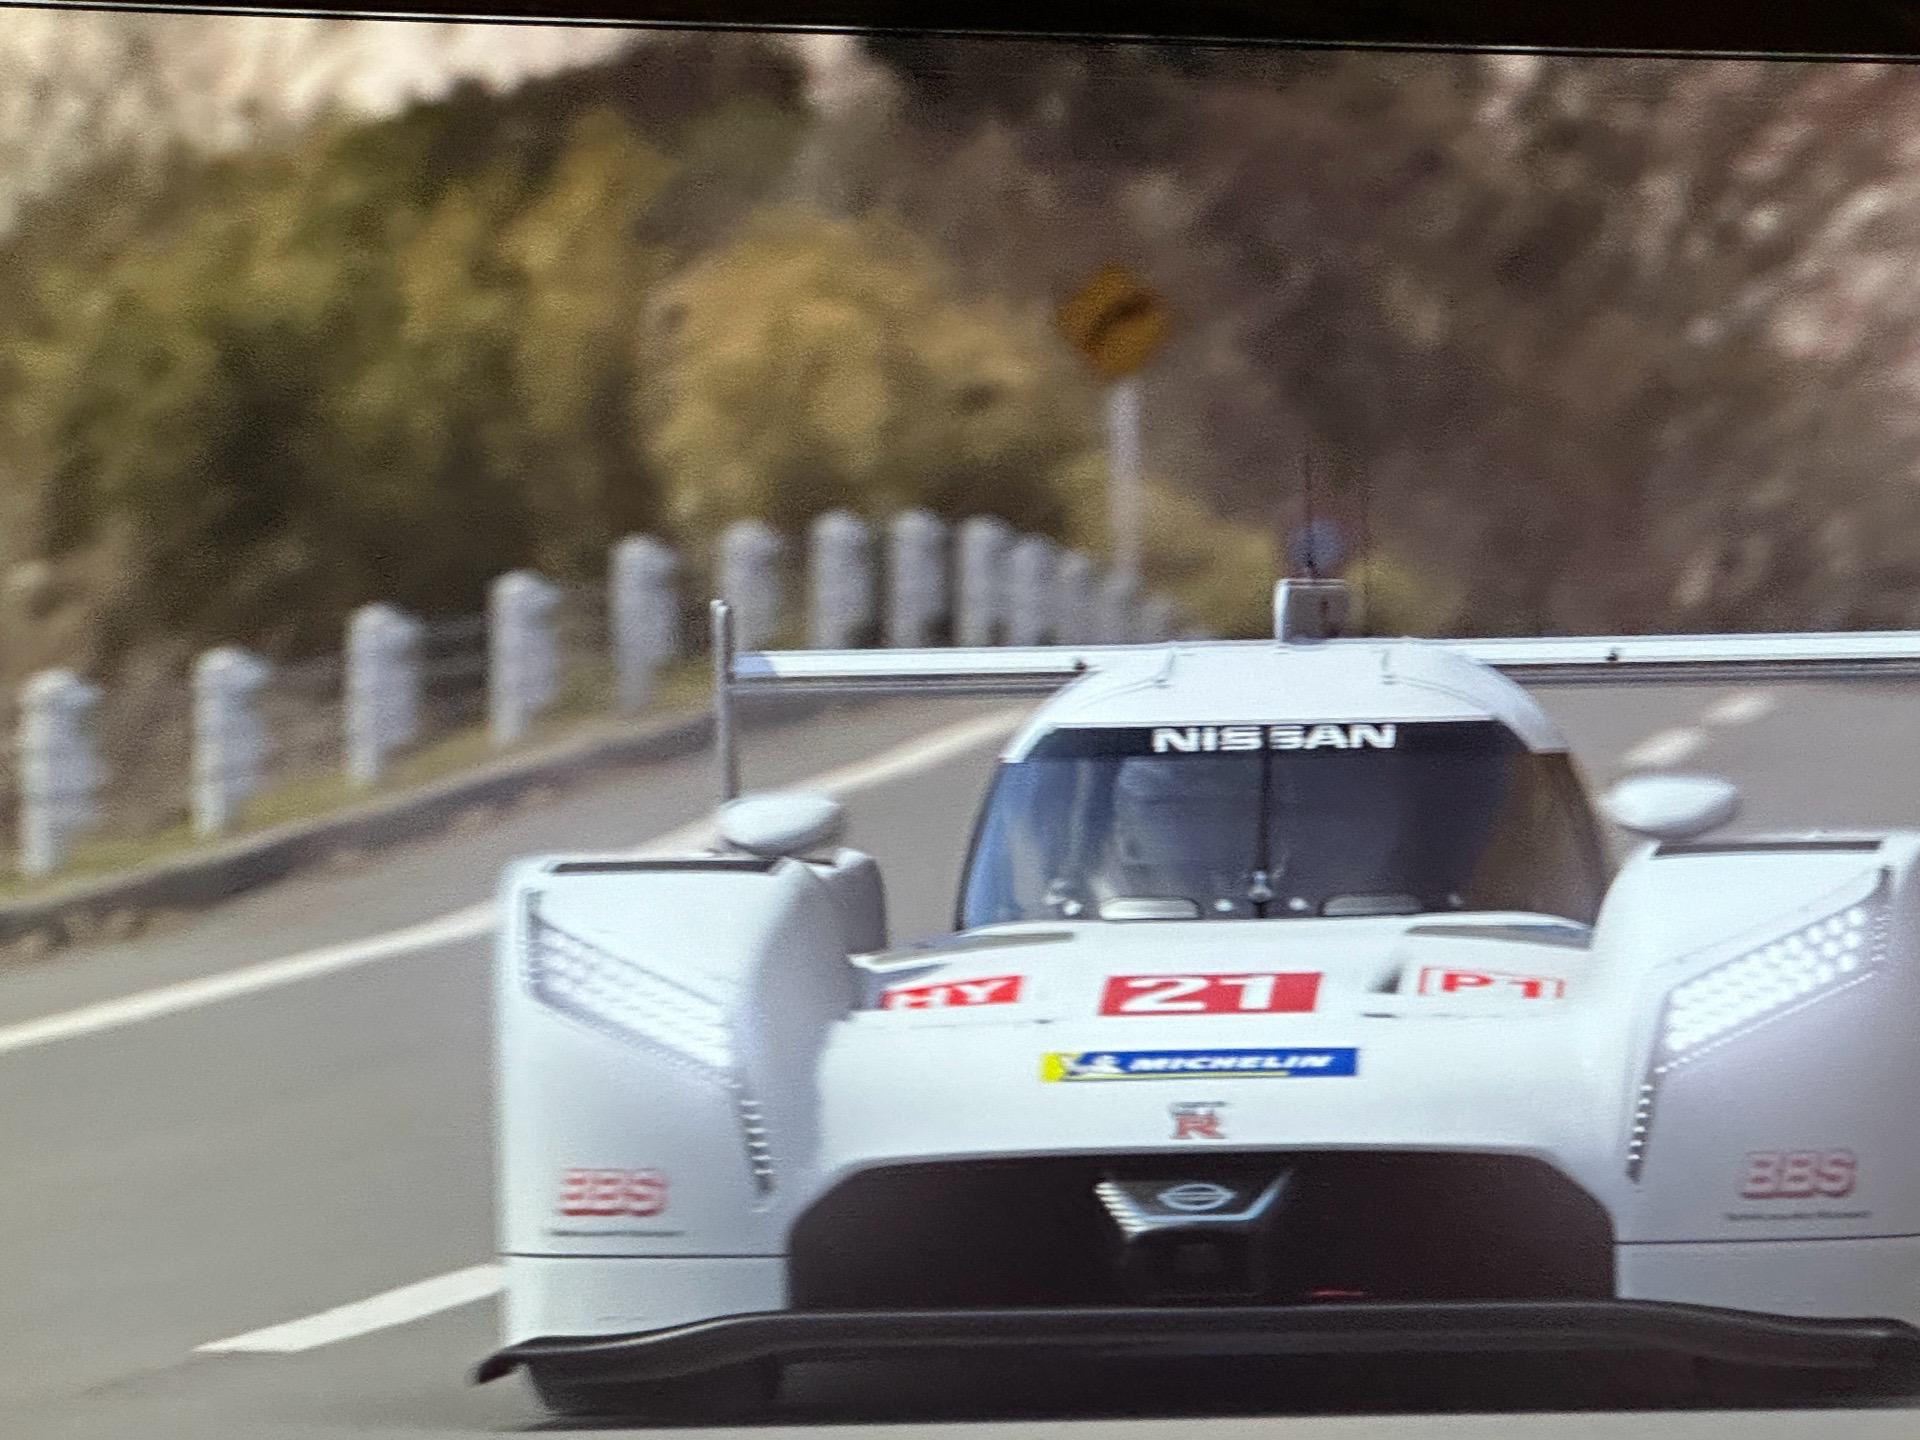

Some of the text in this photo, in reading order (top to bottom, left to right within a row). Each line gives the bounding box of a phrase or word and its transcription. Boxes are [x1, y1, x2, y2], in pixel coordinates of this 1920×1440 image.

[1152, 723, 1397, 752] NISSAN
[1119, 975, 1276, 1012] 21
[1441, 969, 1542, 999] P1
[1128, 1055, 1336, 1072] MICHELIN
